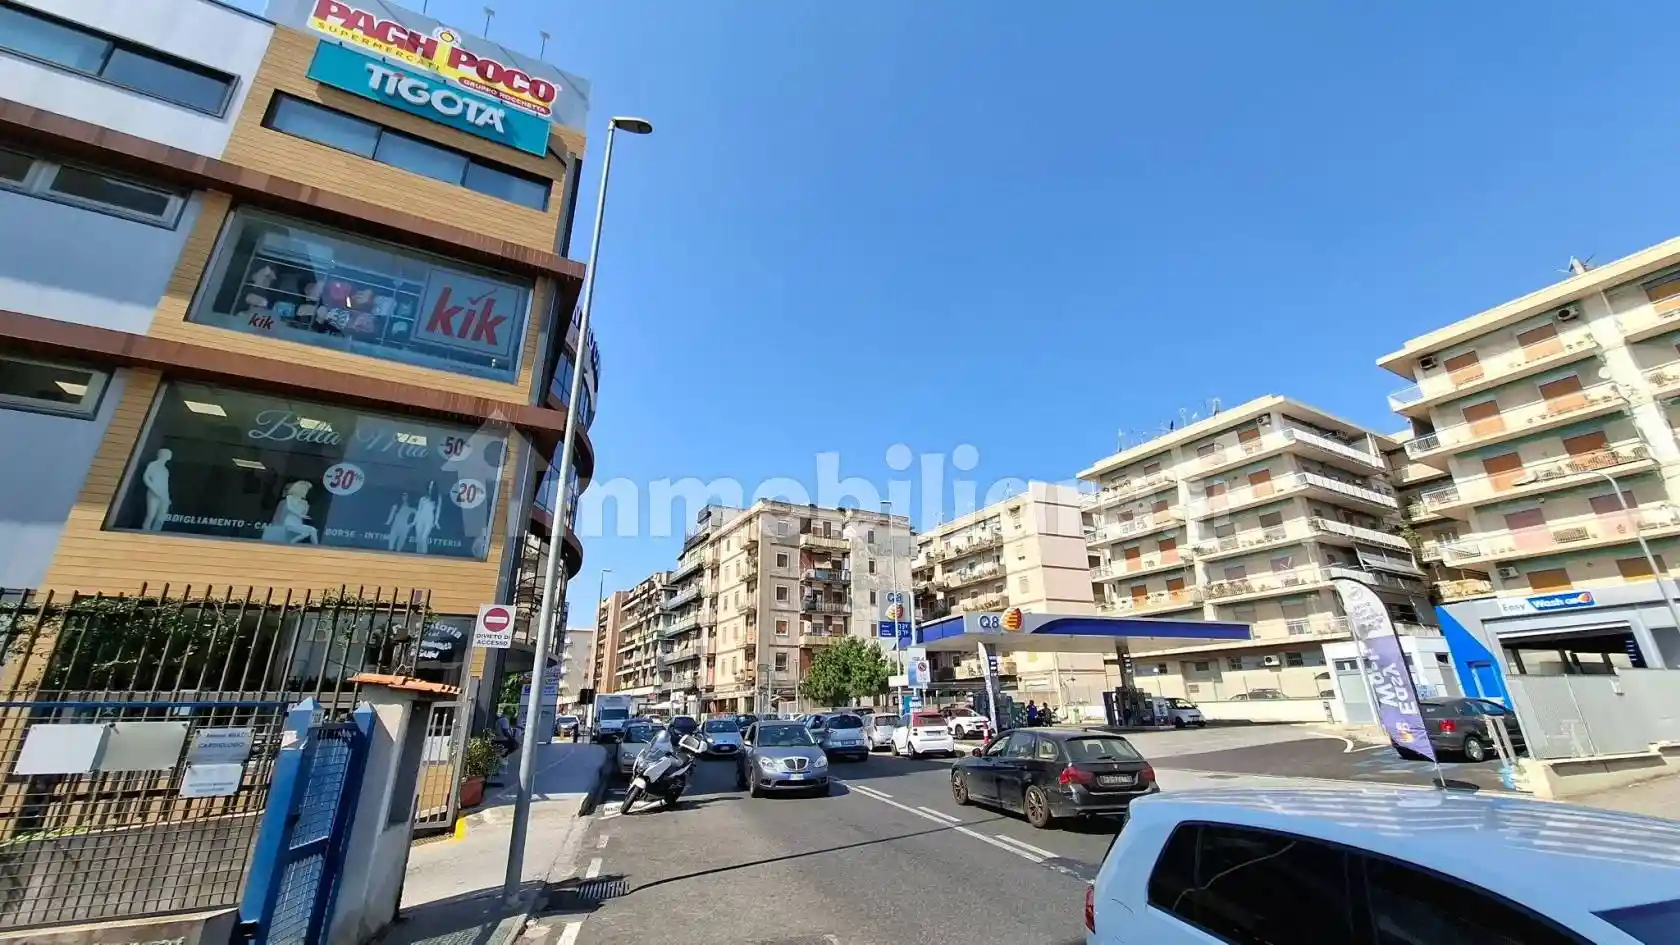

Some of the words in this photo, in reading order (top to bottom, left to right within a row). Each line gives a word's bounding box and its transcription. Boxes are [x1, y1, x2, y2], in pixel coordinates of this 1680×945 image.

[318, 22, 441, 71] SUPERMERCATI
[463, 79, 498, 96] GRUPPO
[500, 92, 546, 114] ROCCHETTA
[166, 513, 245, 528] BBIGLIAMENTO
[325, 528, 357, 539] BORSE
[1531, 597, 1565, 608] Wash
[979, 615, 1000, 629] Q8
